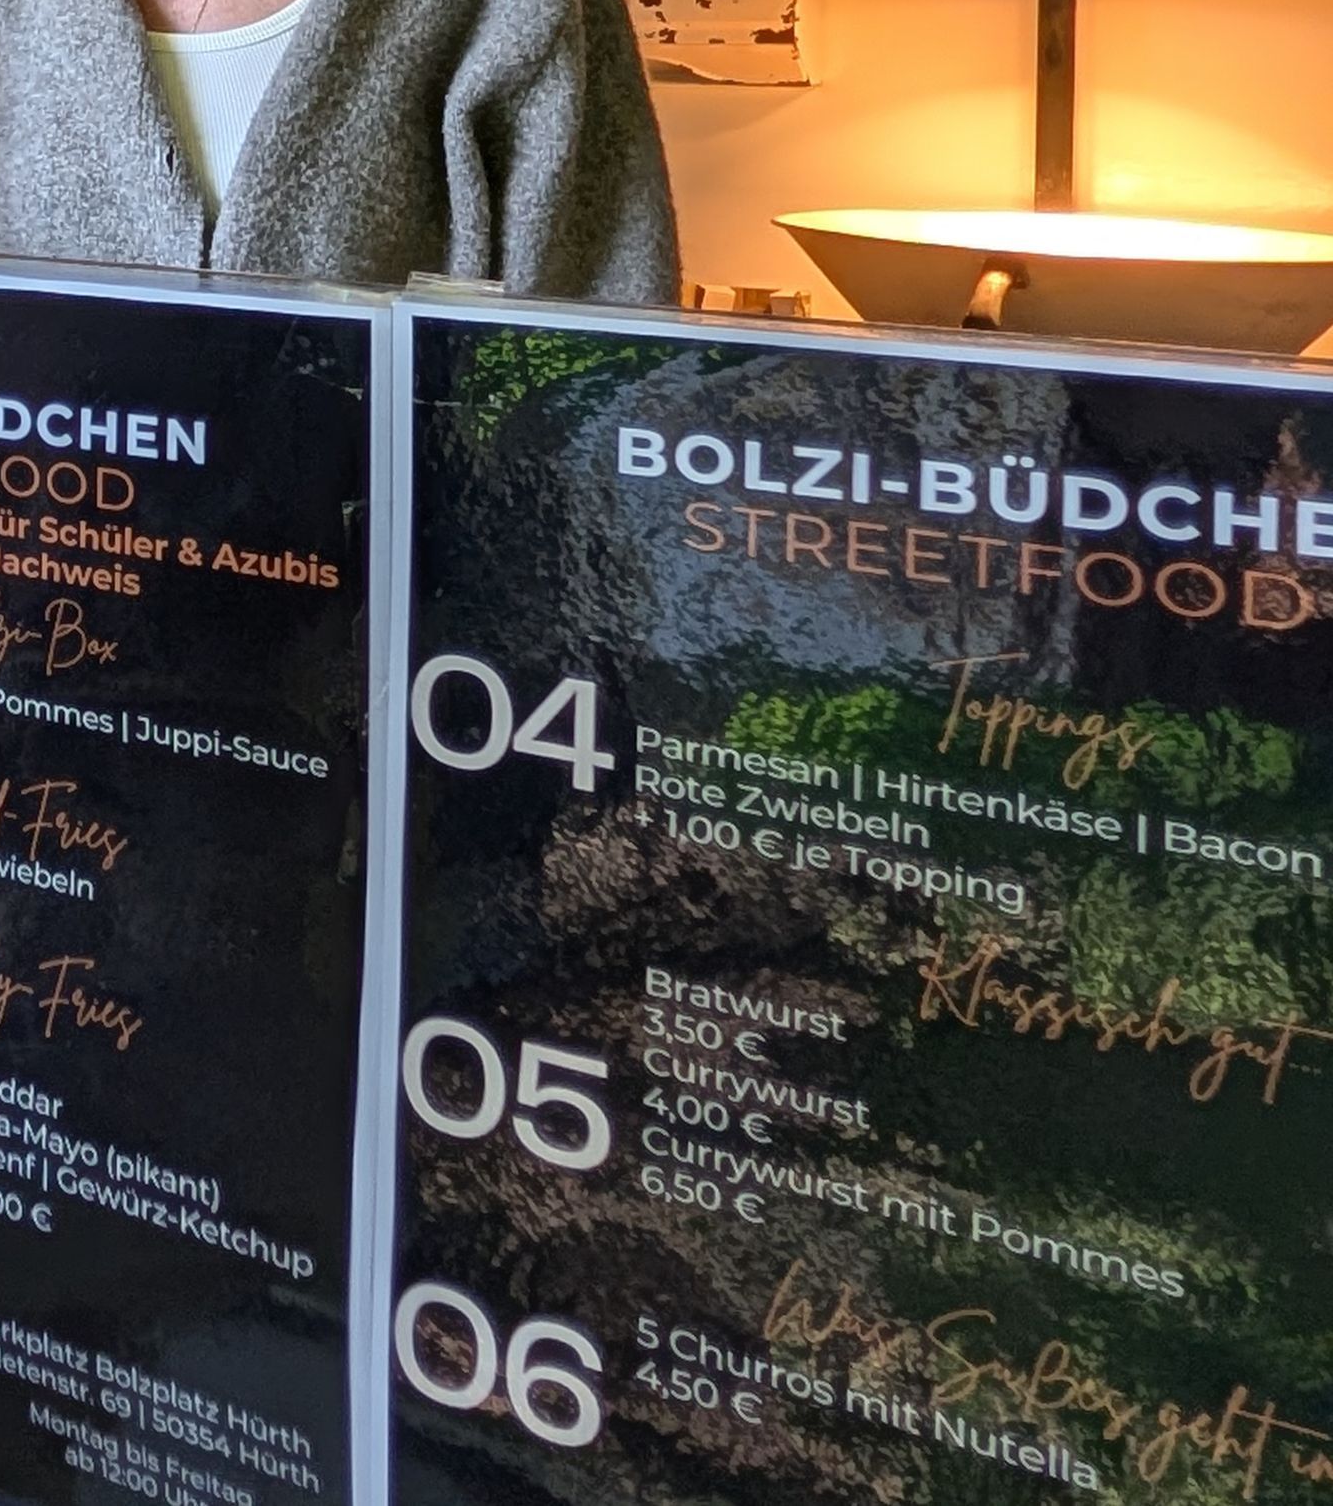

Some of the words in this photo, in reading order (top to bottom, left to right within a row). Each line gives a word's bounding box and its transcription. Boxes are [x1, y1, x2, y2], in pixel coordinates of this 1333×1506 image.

[39, 514, 168, 564] Schüler
[178, 536, 202, 566] &
[212, 541, 340, 589] Azubis
[684, 501, 1317, 631] STREETFOOD
[136, 715, 329, 779] Juppi-Sauce
[410, 653, 616, 794] 04
[933, 652, 1159, 791] Toppings
[634, 764, 725, 817] Rote
[736, 782, 930, 850] Zwiebeln
[636, 724, 839, 792] Parmesan
[877, 768, 1123, 843] Hirtenkäse
[1163, 821, 1324, 880] Bacon
[664, 806, 740, 854] 1,00
[752, 829, 784, 863] €
[793, 835, 832, 874] je
[842, 842, 1027, 916] Topping
[642, 1006, 725, 1054] 3,50
[734, 1027, 768, 1063] €
[644, 966, 847, 1046] Bratwurst
[402, 1017, 613, 1172] 05
[641, 1088, 730, 1139] 4,00
[740, 1109, 774, 1145] €
[642, 1045, 872, 1132] Currywurst
[31, 1202, 54, 1234] €
[56, 1164, 316, 1284] Gewürz-Ketchup
[107, 1138, 221, 1213] (pikant)
[640, 1167, 722, 1217] 6,50
[733, 1189, 766, 1226] €
[641, 1126, 871, 1216] Currywurst
[881, 1183, 958, 1239] mit
[971, 1209, 1187, 1301] Pommes
[95, 1354, 220, 1425] Bolzplatz
[227, 1404, 312, 1460] Hürth
[395, 1280, 604, 1449] 06
[635, 1361, 720, 1413] 4,50
[730, 1387, 763, 1427] €
[636, 1315, 662, 1352] 5
[668, 1329, 836, 1405] Churros
[846, 1382, 923, 1436] mit
[934, 1411, 1102, 1495] Nutella
[30, 1402, 119, 1462] Montag
[125, 1438, 160, 1474] bis
[166, 1456, 253, 1506] Freitag
[64, 1446, 94, 1473] ab
[100, 1457, 158, 1498] 12:00
[100, 1392, 132, 1419] 69
[152, 1412, 233, 1460] 50354
[239, 1442, 321, 1494] Hürth
